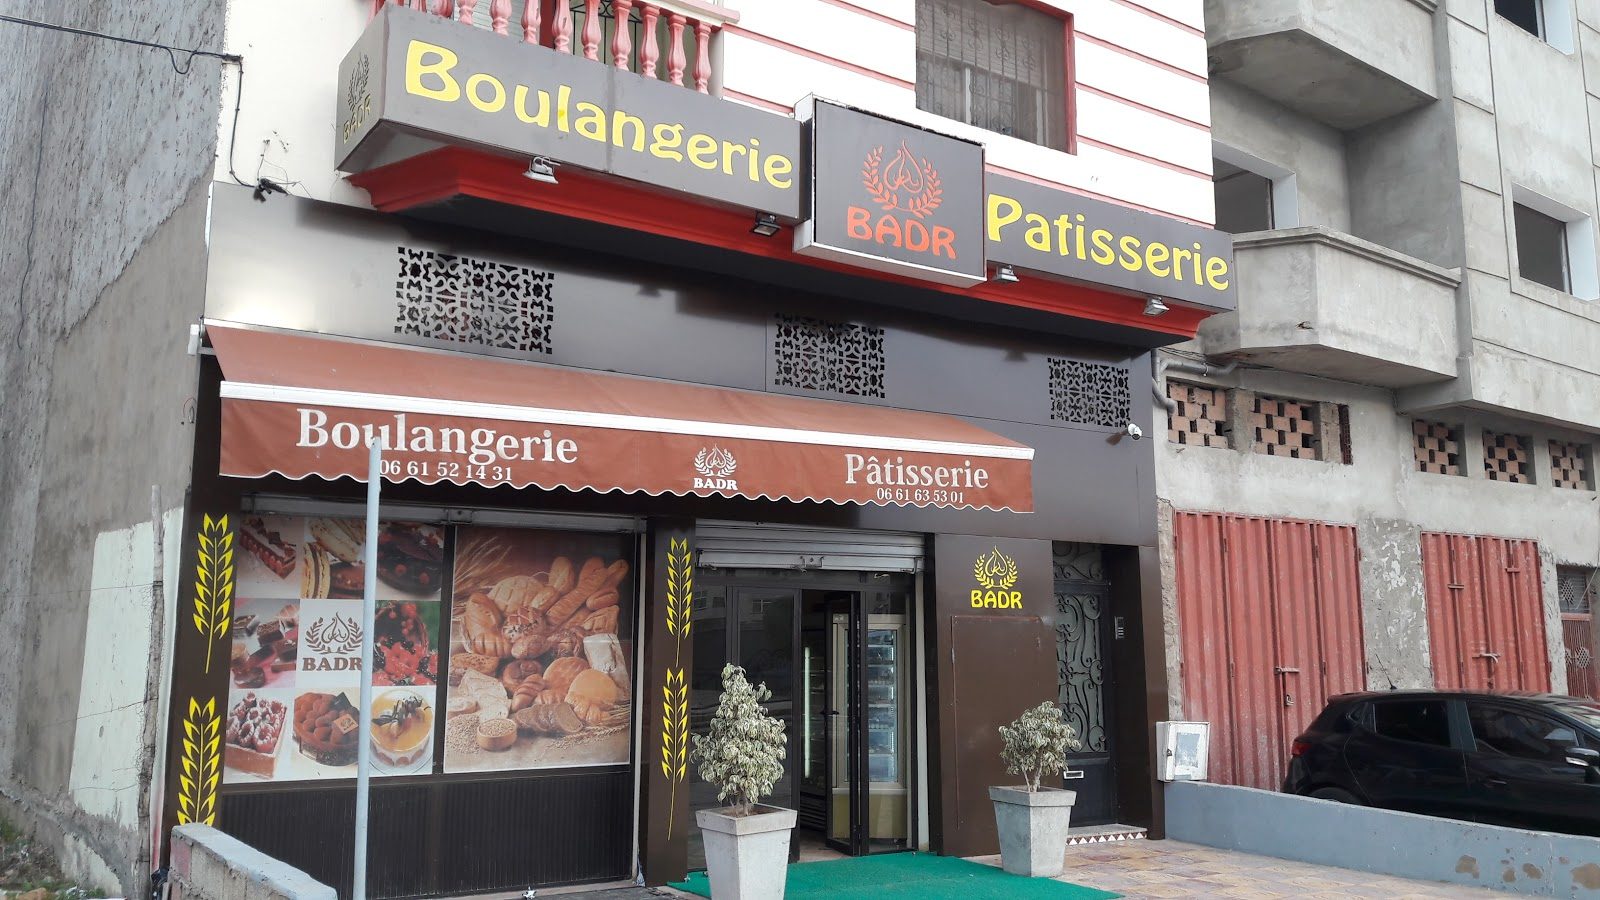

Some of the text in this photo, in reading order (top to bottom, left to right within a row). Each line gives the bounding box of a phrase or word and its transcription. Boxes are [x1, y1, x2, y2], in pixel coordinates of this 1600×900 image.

[405, 39, 793, 189] Boulangerie
[847, 205, 957, 260] BADR
[986, 194, 1230, 291] Patisserie
[296, 408, 579, 466] Boulangerie
[380, 459, 512, 481] 06 61 52 14 31
[693, 477, 738, 491] BADR
[845, 453, 989, 489] Pâtisserie
[877, 487, 964, 503] 06 61 63 53 01
[971, 589, 1023, 609] BADR
[302, 657, 362, 671] BADR
